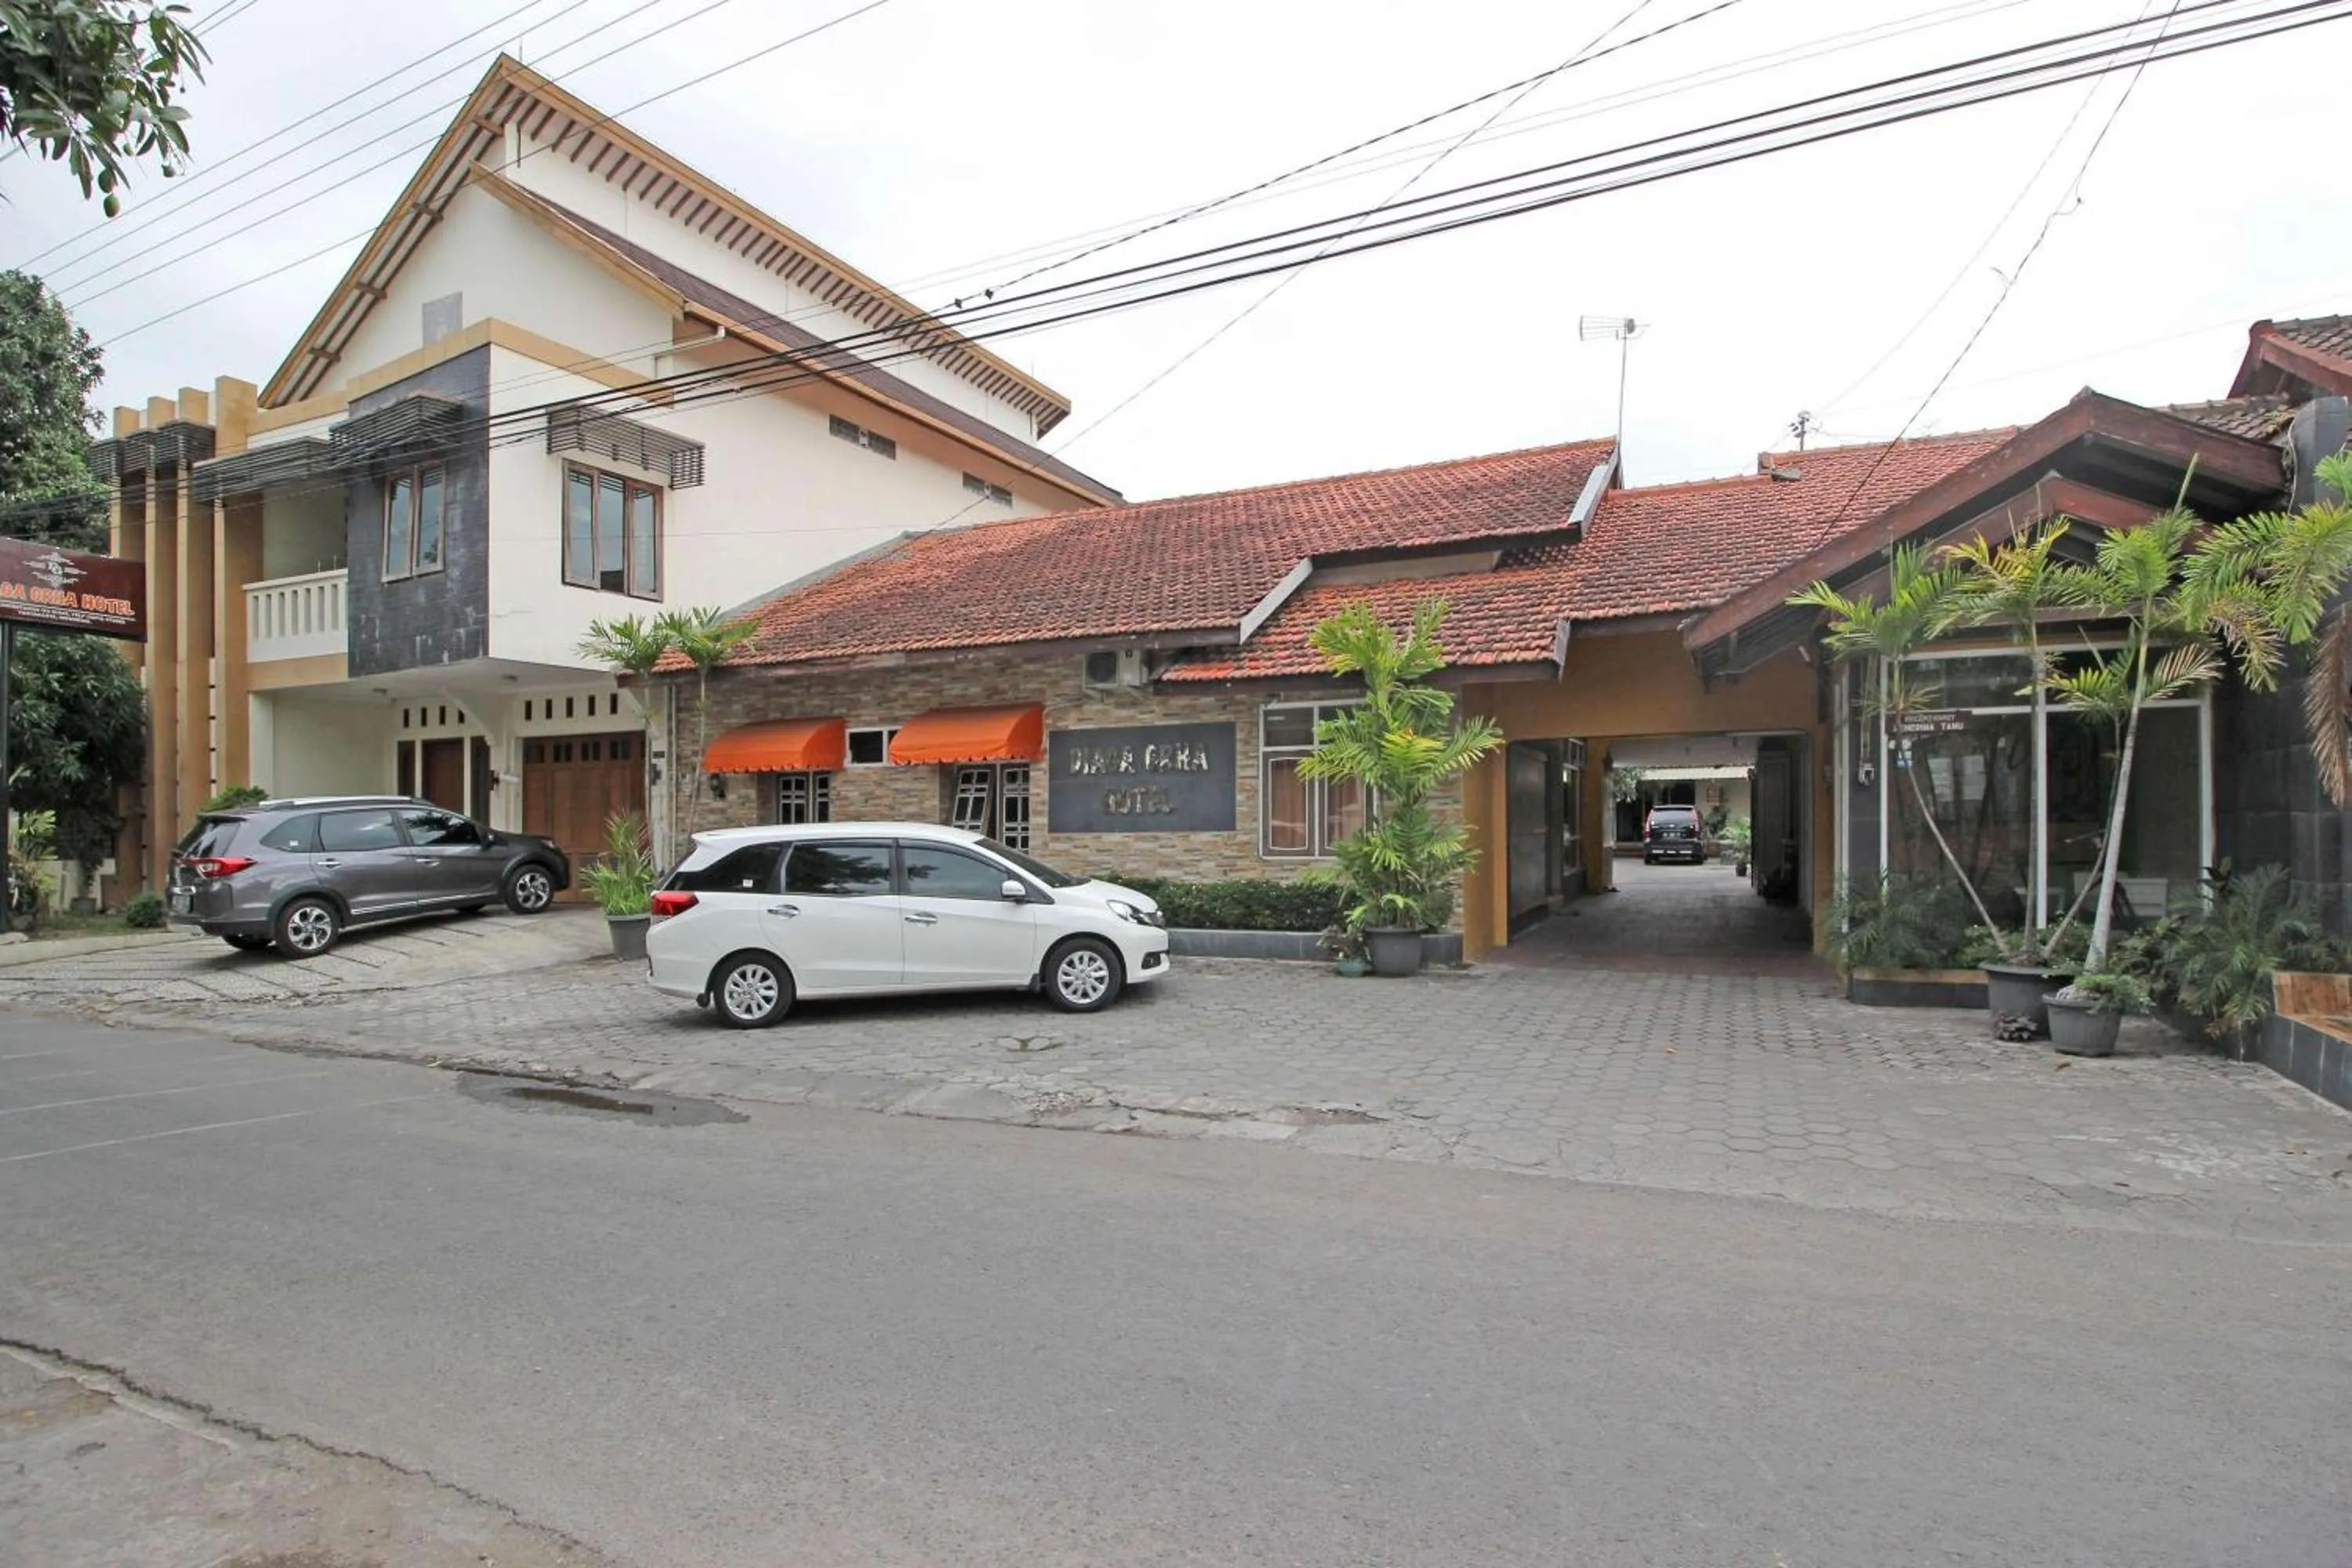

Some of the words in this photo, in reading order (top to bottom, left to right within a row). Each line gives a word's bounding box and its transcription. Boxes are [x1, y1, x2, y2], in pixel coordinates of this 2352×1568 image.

[82, 594, 135, 615] HOTEL
[1940, 721, 1965, 730] TAMU
[1103, 785, 1174, 815] HOTEL
